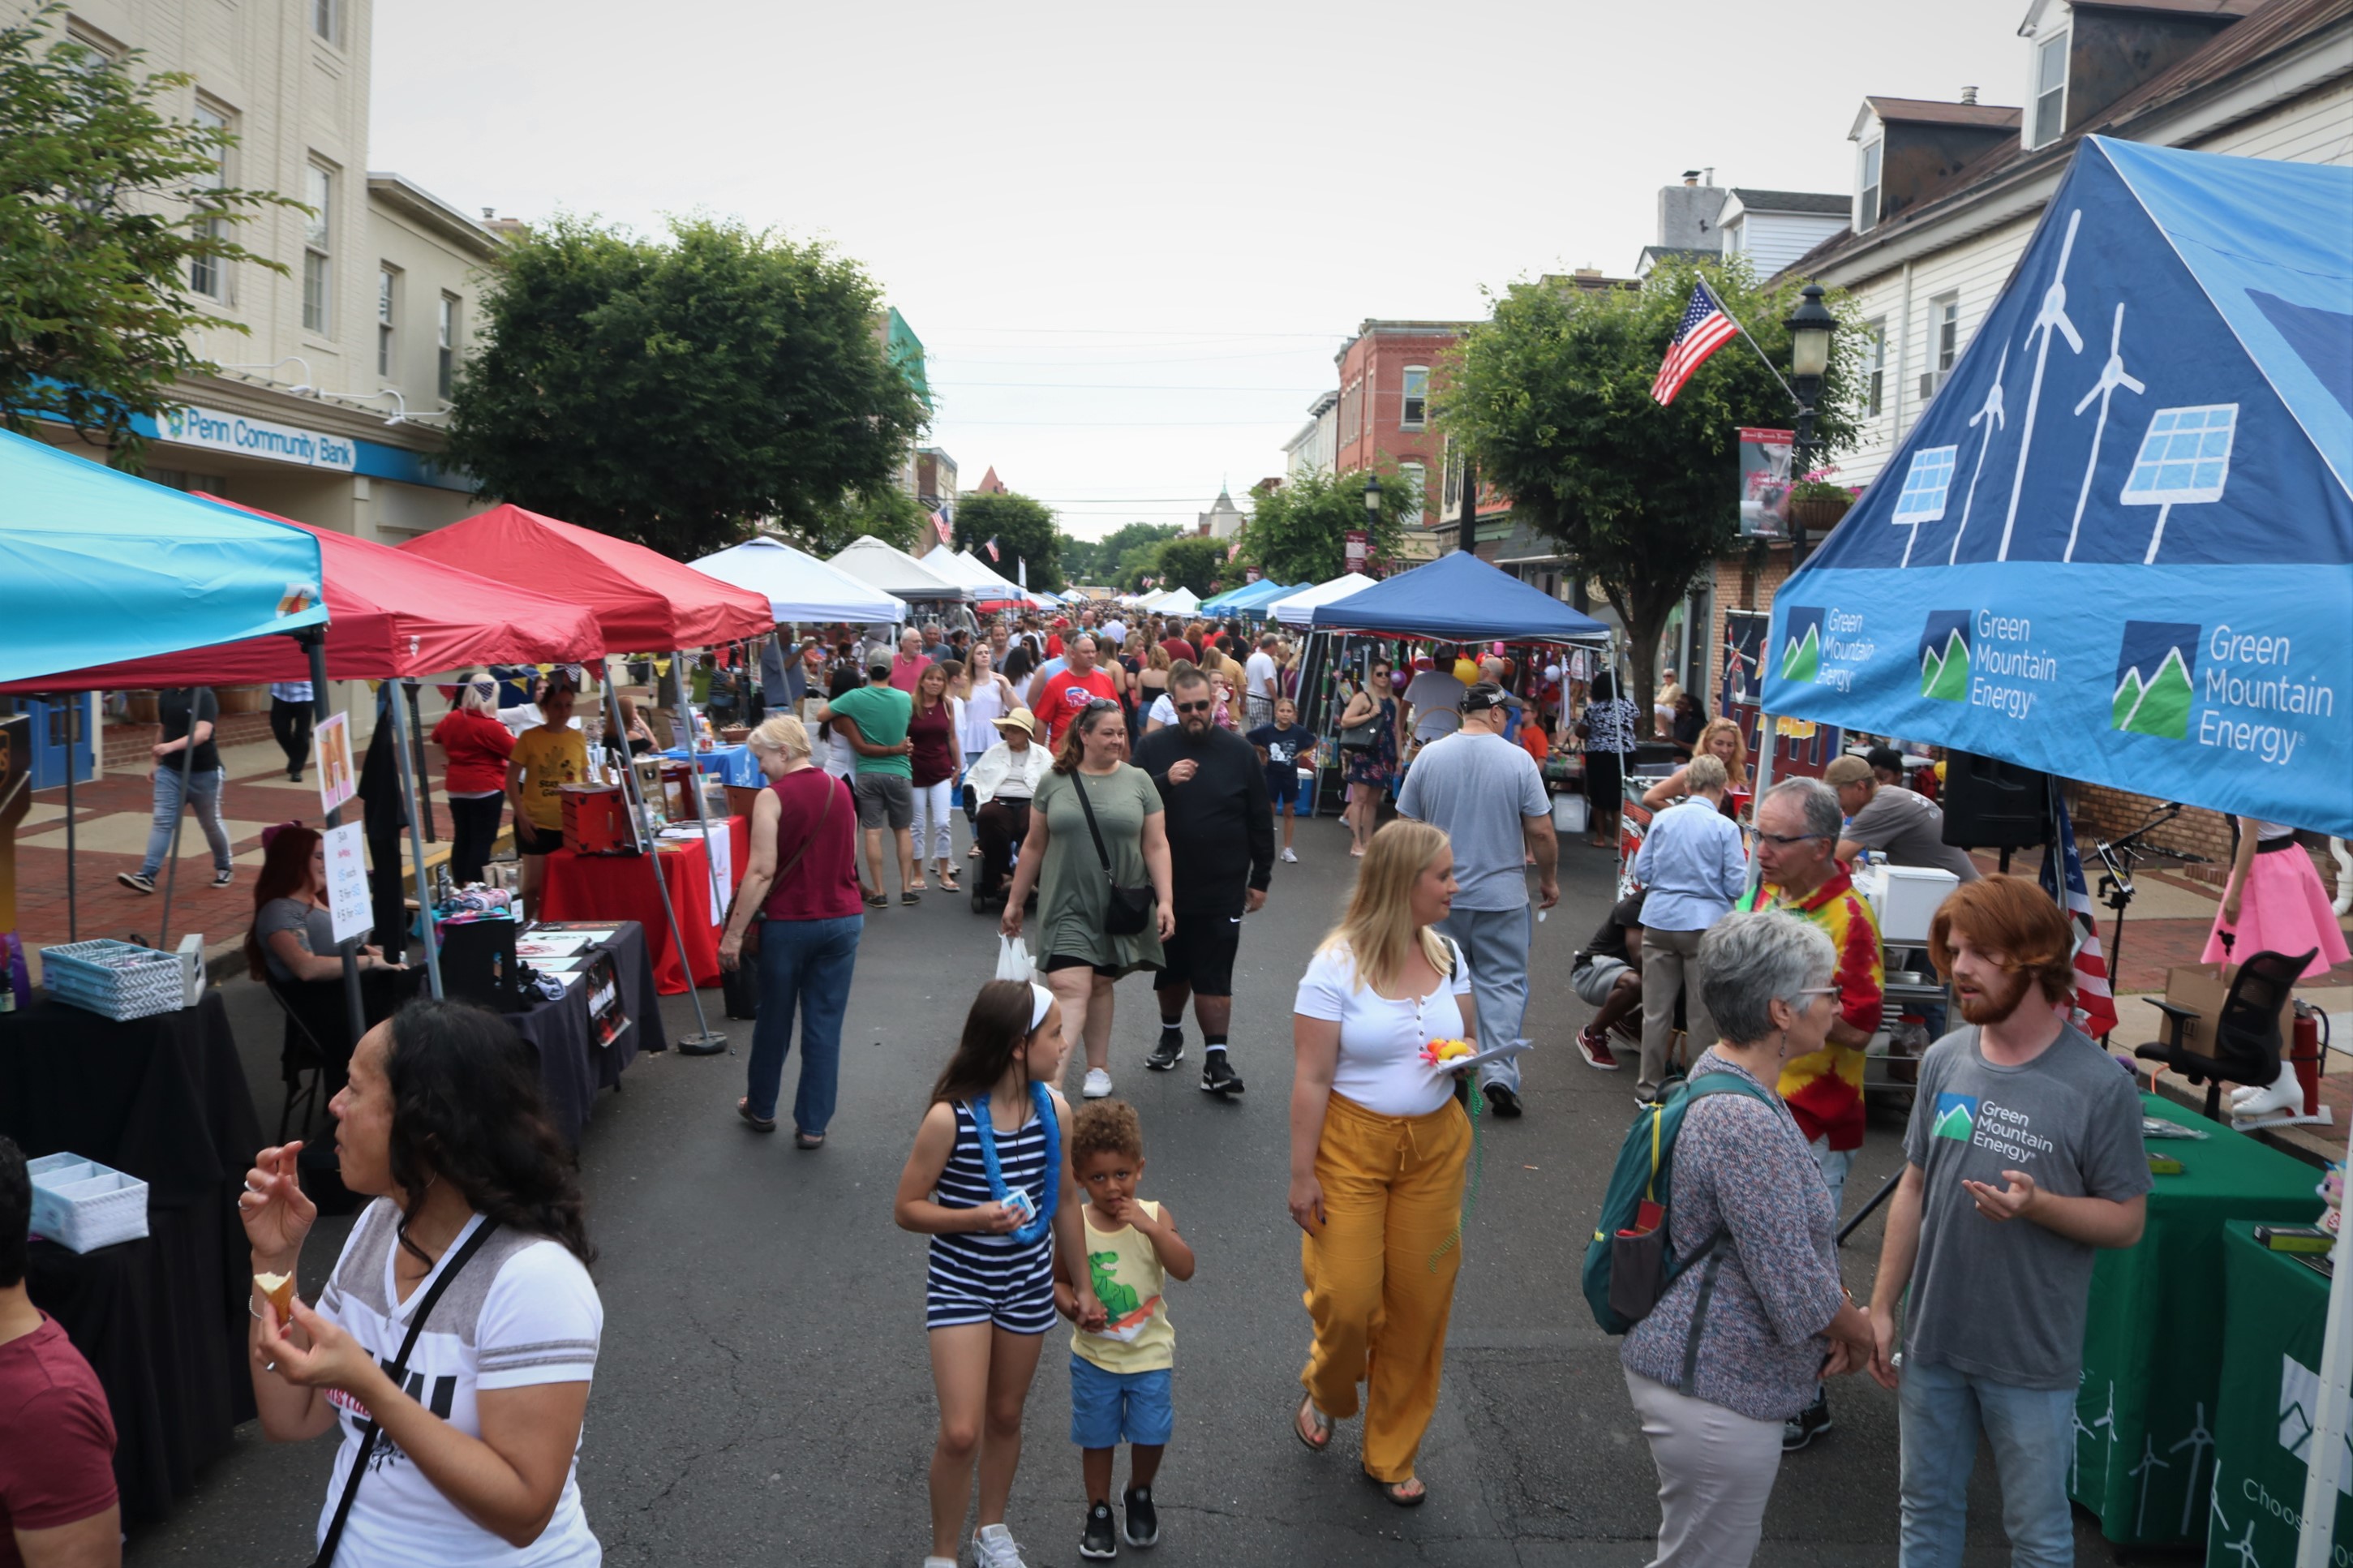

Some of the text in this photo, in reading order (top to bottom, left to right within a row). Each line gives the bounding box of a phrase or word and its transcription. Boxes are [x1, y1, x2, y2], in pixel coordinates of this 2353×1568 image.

[187, 409, 351, 466] Penn Community Bank
[1828, 608, 1863, 633] Green
[1977, 608, 2030, 642] Green
[1823, 635, 1874, 662] Mountain
[1975, 642, 2056, 681] Mountain
[2210, 625, 2290, 666] Green
[1815, 662, 1856, 693] Eergy
[2205, 667, 2334, 717] Mountain
[1982, 1100, 2029, 1128] Green
[1977, 1115, 2053, 1153] Mountain
[2243, 1477, 2303, 1533] Choos
